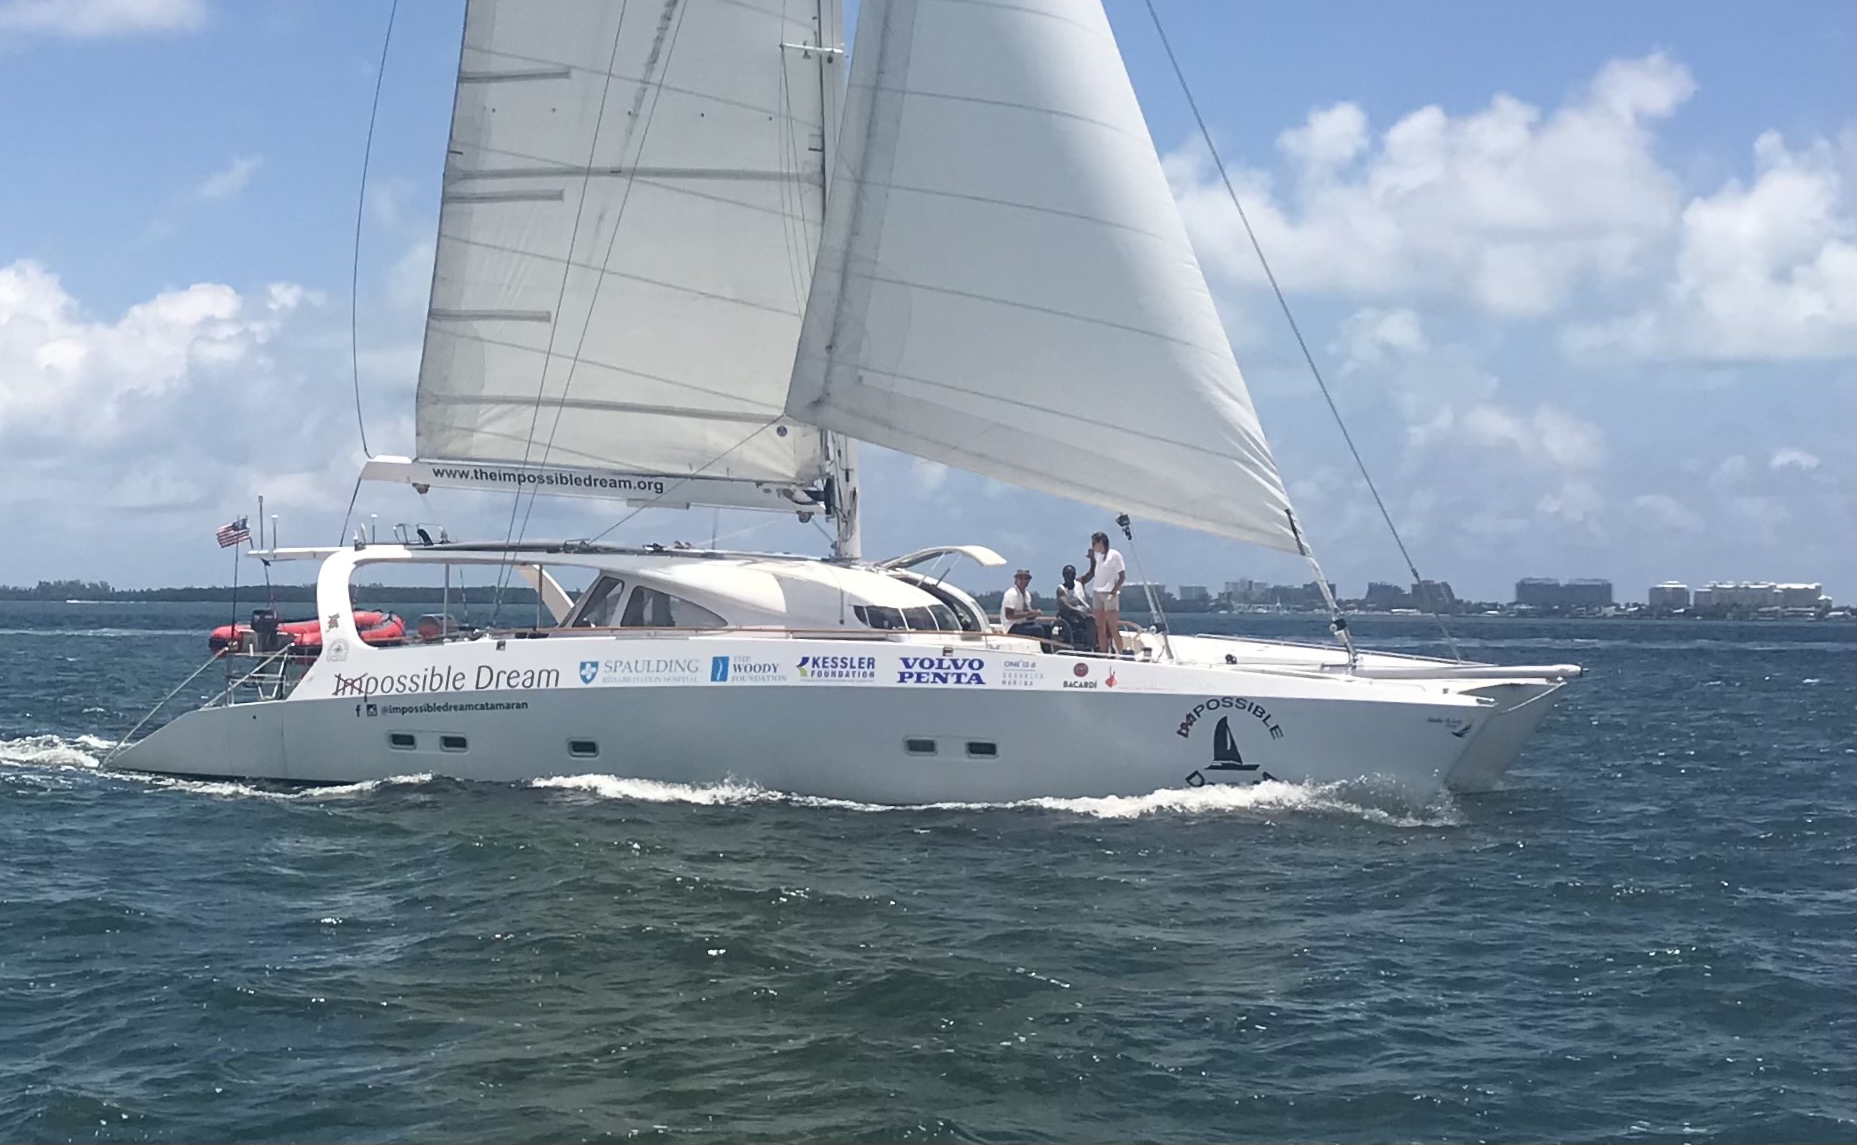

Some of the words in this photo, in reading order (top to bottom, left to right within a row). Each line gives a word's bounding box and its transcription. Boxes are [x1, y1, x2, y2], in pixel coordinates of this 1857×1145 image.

[432, 466, 664, 494] www.theimpossibledream.org
[603, 659, 699, 674] SPAULDING
[733, 663, 779, 674] WOODY
[812, 656, 876, 670] KESSLER
[899, 657, 985, 671] VOLVO
[475, 665, 560, 690] Dream
[811, 670, 875, 678] FOUNDATION
[897, 671, 987, 685] PENTA
